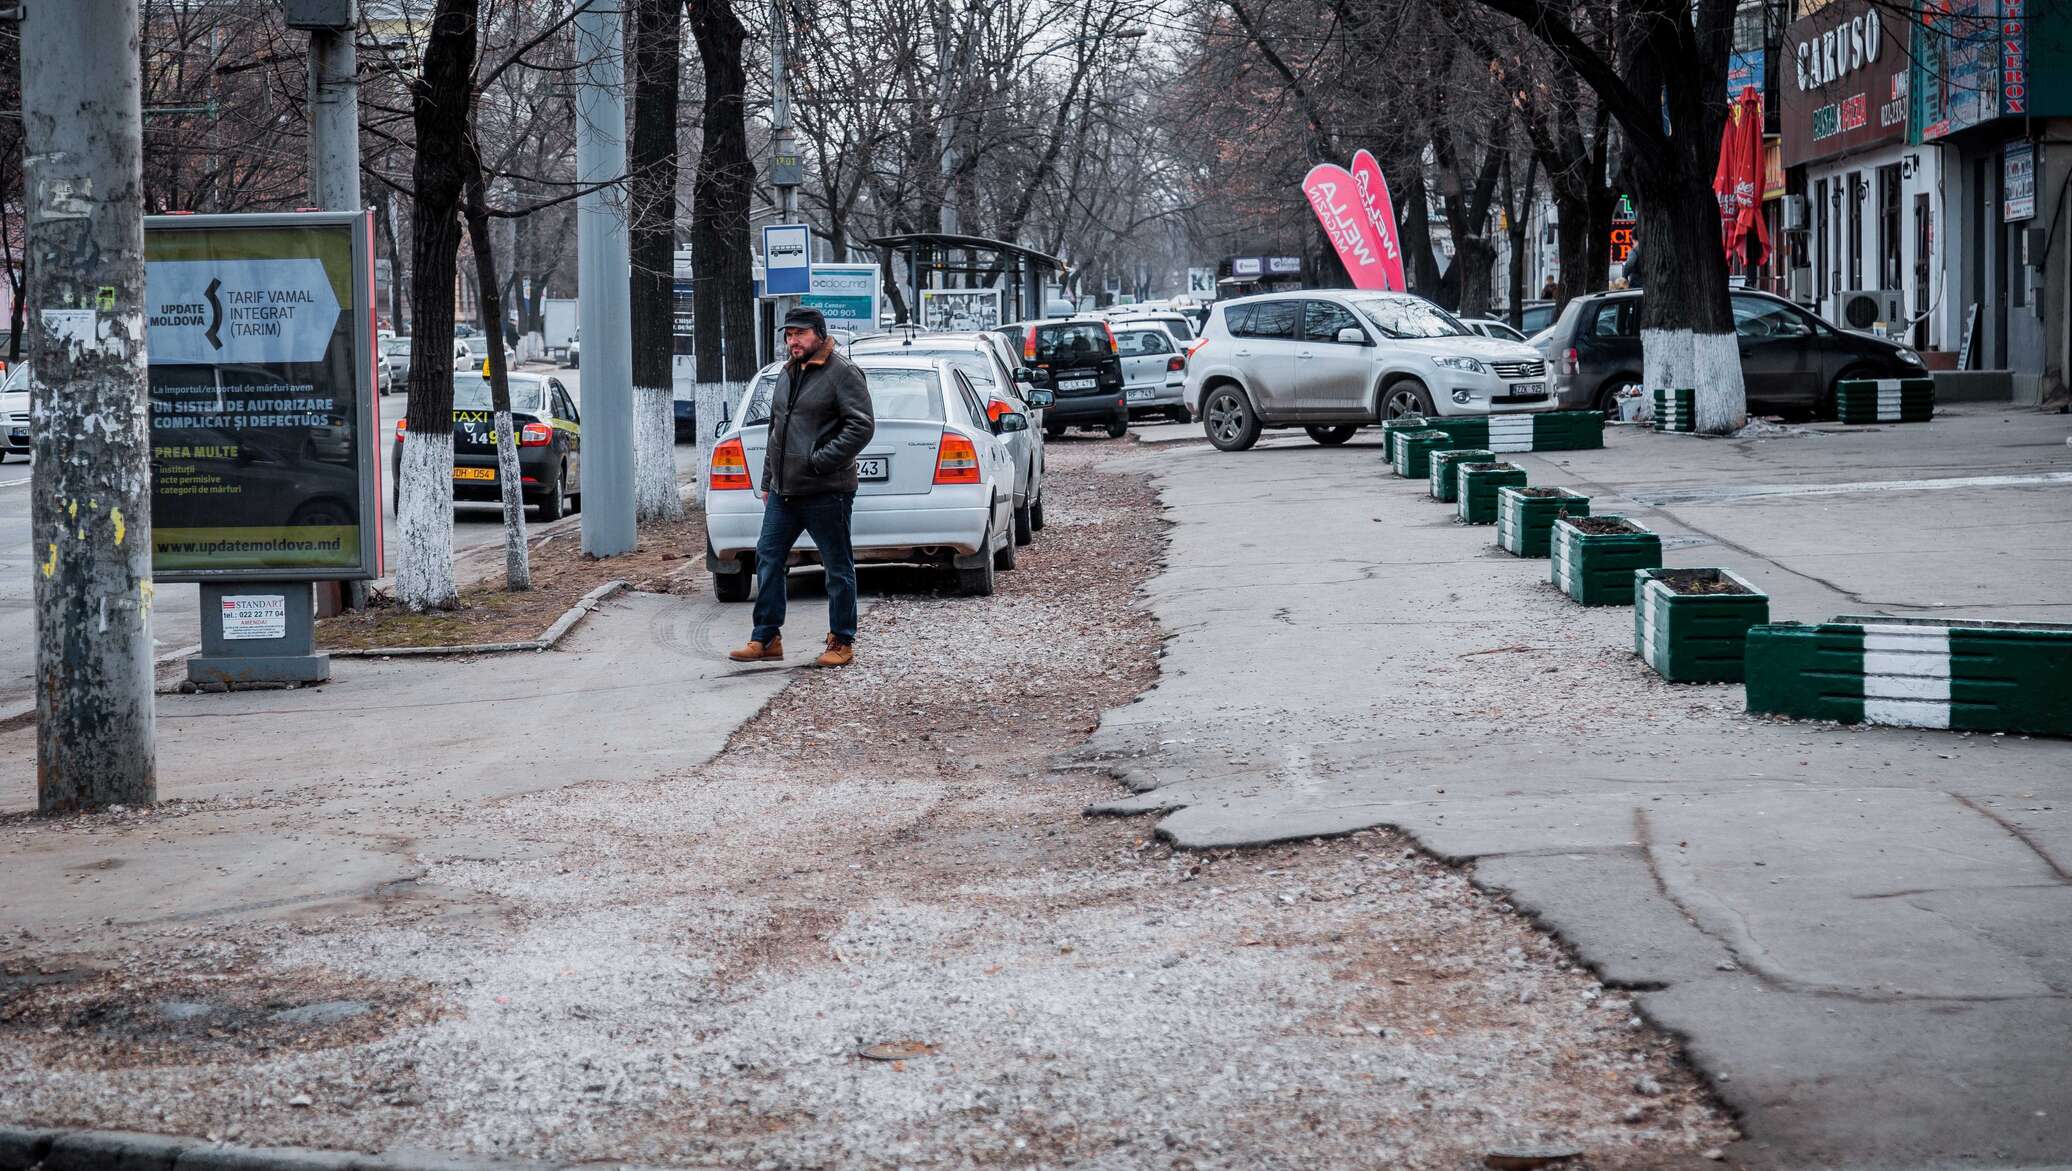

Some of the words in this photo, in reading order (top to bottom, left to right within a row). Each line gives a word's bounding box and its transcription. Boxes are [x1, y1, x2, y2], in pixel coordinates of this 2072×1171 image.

[1798, 8, 1880, 91] CARUSO
[2004, 0, 2024, 113] TOXEROX
[812, 279, 866, 288] ocdoc.md
[227, 291, 264, 304] TARIF
[268, 290, 314, 303] VAMAL
[162, 304, 204, 314] UPDATE
[230, 306, 295, 320] INTEGRAT
[840, 309, 856, 317] 903
[150, 316, 205, 326] MOLDOVA
[230, 323, 281, 338] (TARIM)
[164, 384, 242, 395] importul/exportul
[244, 384, 255, 393] de
[154, 401, 174, 413] UN
[175, 401, 224, 412] SISTEM
[227, 400, 244, 412] DE
[247, 399, 333, 411] AUTORIZARE
[154, 416, 230, 428] COMPLICAT
[234, 416, 247, 431] ȘI
[250, 414, 328, 427] DEFECTUOS
[453, 412, 488, 423] TAXI
[154, 447, 191, 458] PREA
[194, 446, 239, 458] MULTE
[179, 476, 221, 486] permisive
[160, 487, 197, 496] categorii
[157, 537, 340, 555] www.updatemoldova.md
[236, 600, 282, 609] STANDART
